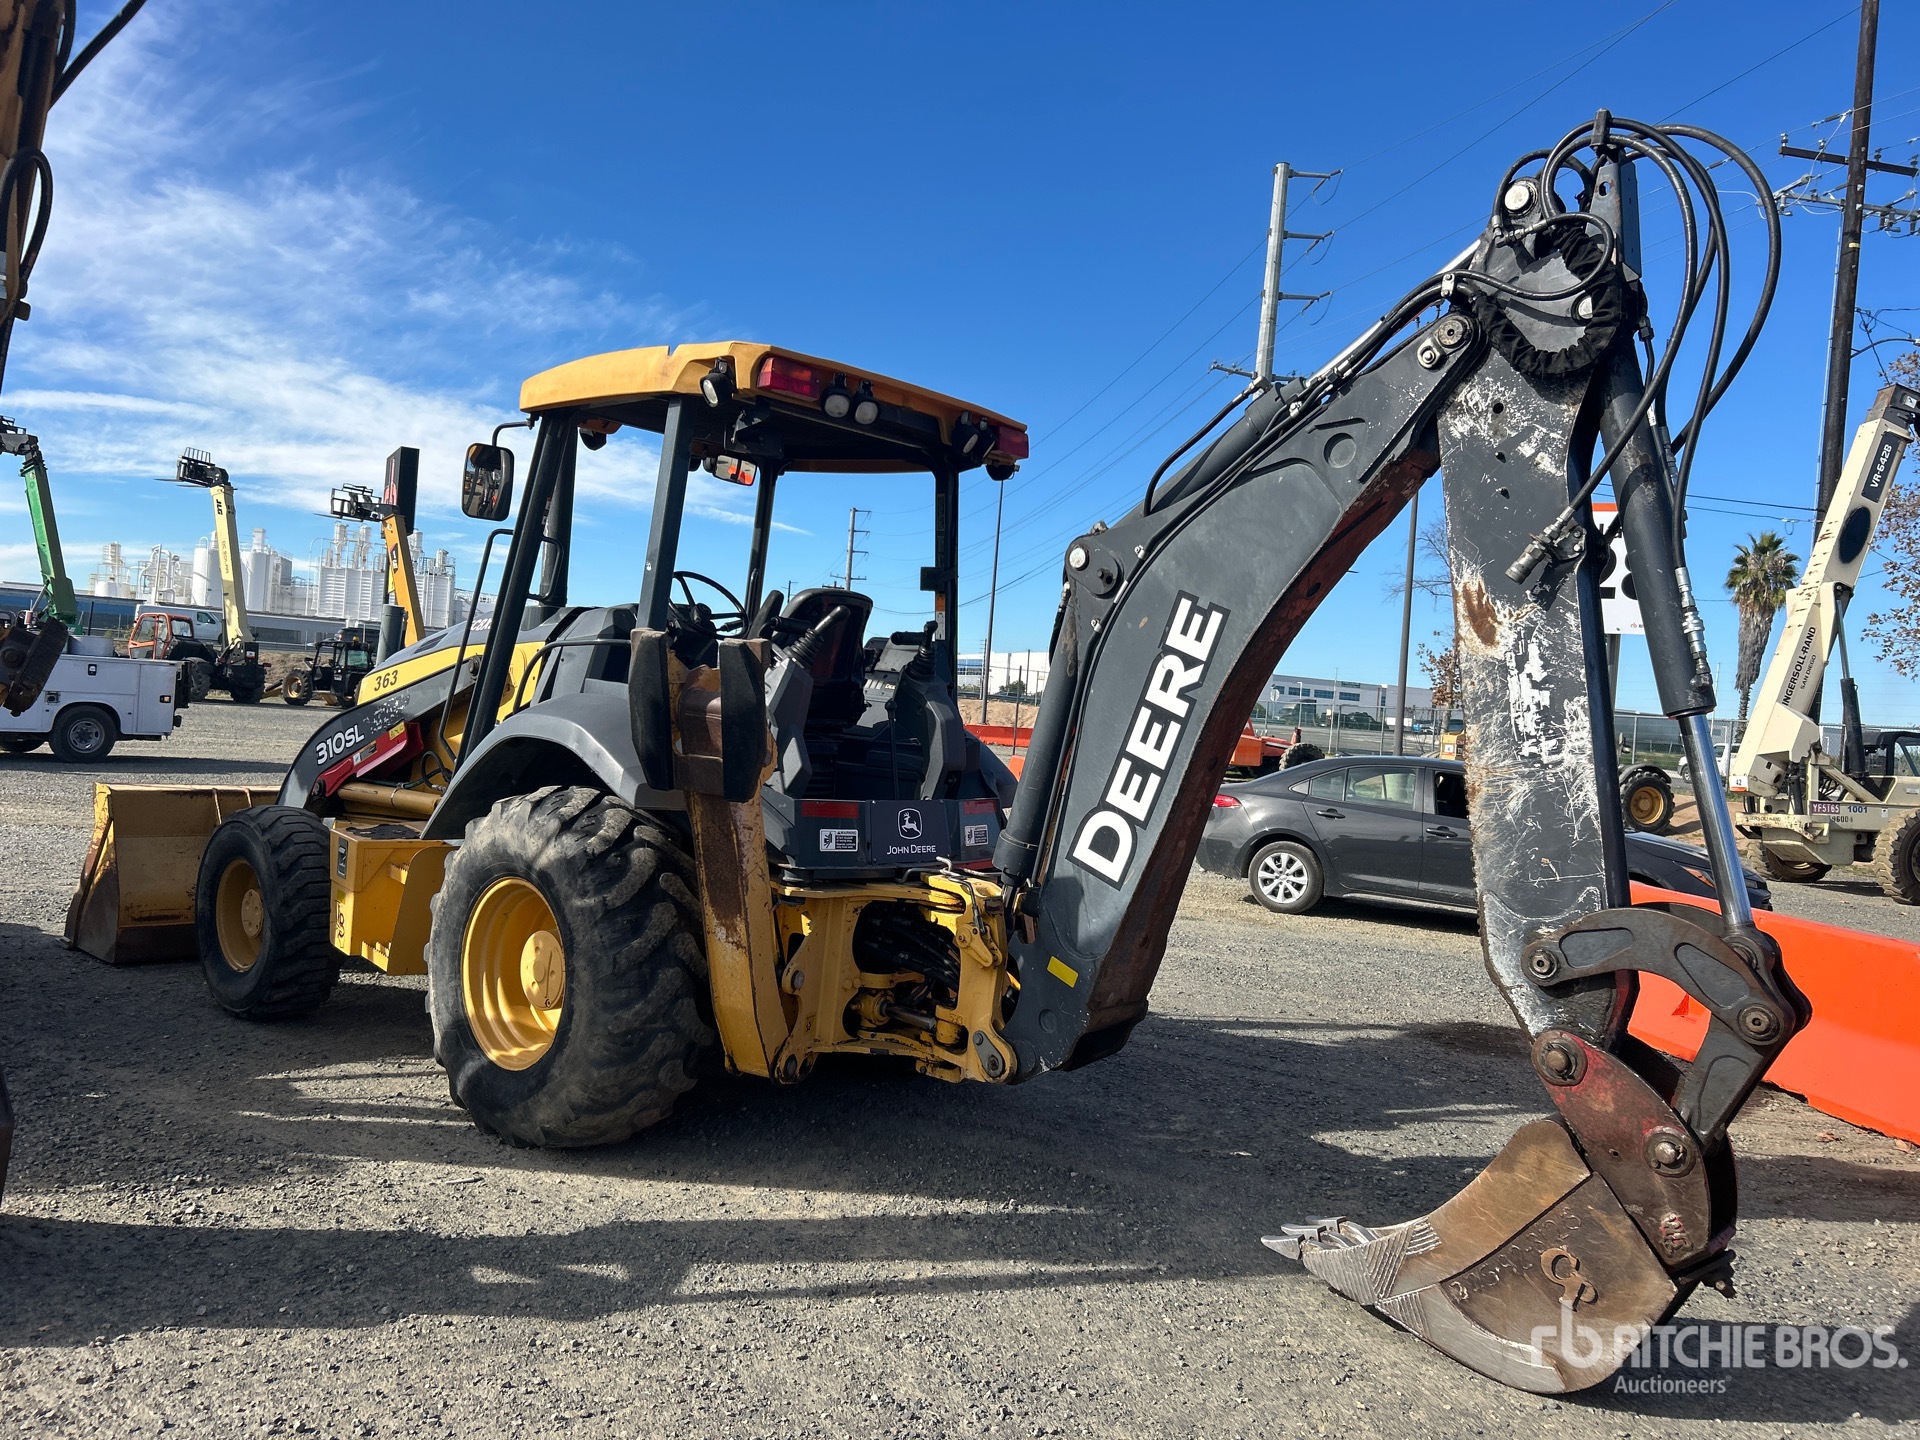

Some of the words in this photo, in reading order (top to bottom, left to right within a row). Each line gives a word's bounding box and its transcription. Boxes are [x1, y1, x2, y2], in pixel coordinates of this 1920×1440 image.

[1869, 443, 1893, 488] VR-642B
[374, 669, 399, 692] 363
[1781, 626, 1817, 706] INGERSOLL-RAND
[1800, 675, 1810, 690] SAN
[1805, 654, 1817, 675] DIEGO
[315, 724, 366, 766] 310SL
[1070, 595, 1225, 885] DEERE
[1812, 803, 1840, 813] YF5T65
[1847, 805, 1868, 814] 1001
[886, 845, 910, 855] JOHN
[910, 844, 937, 854] DEERE
